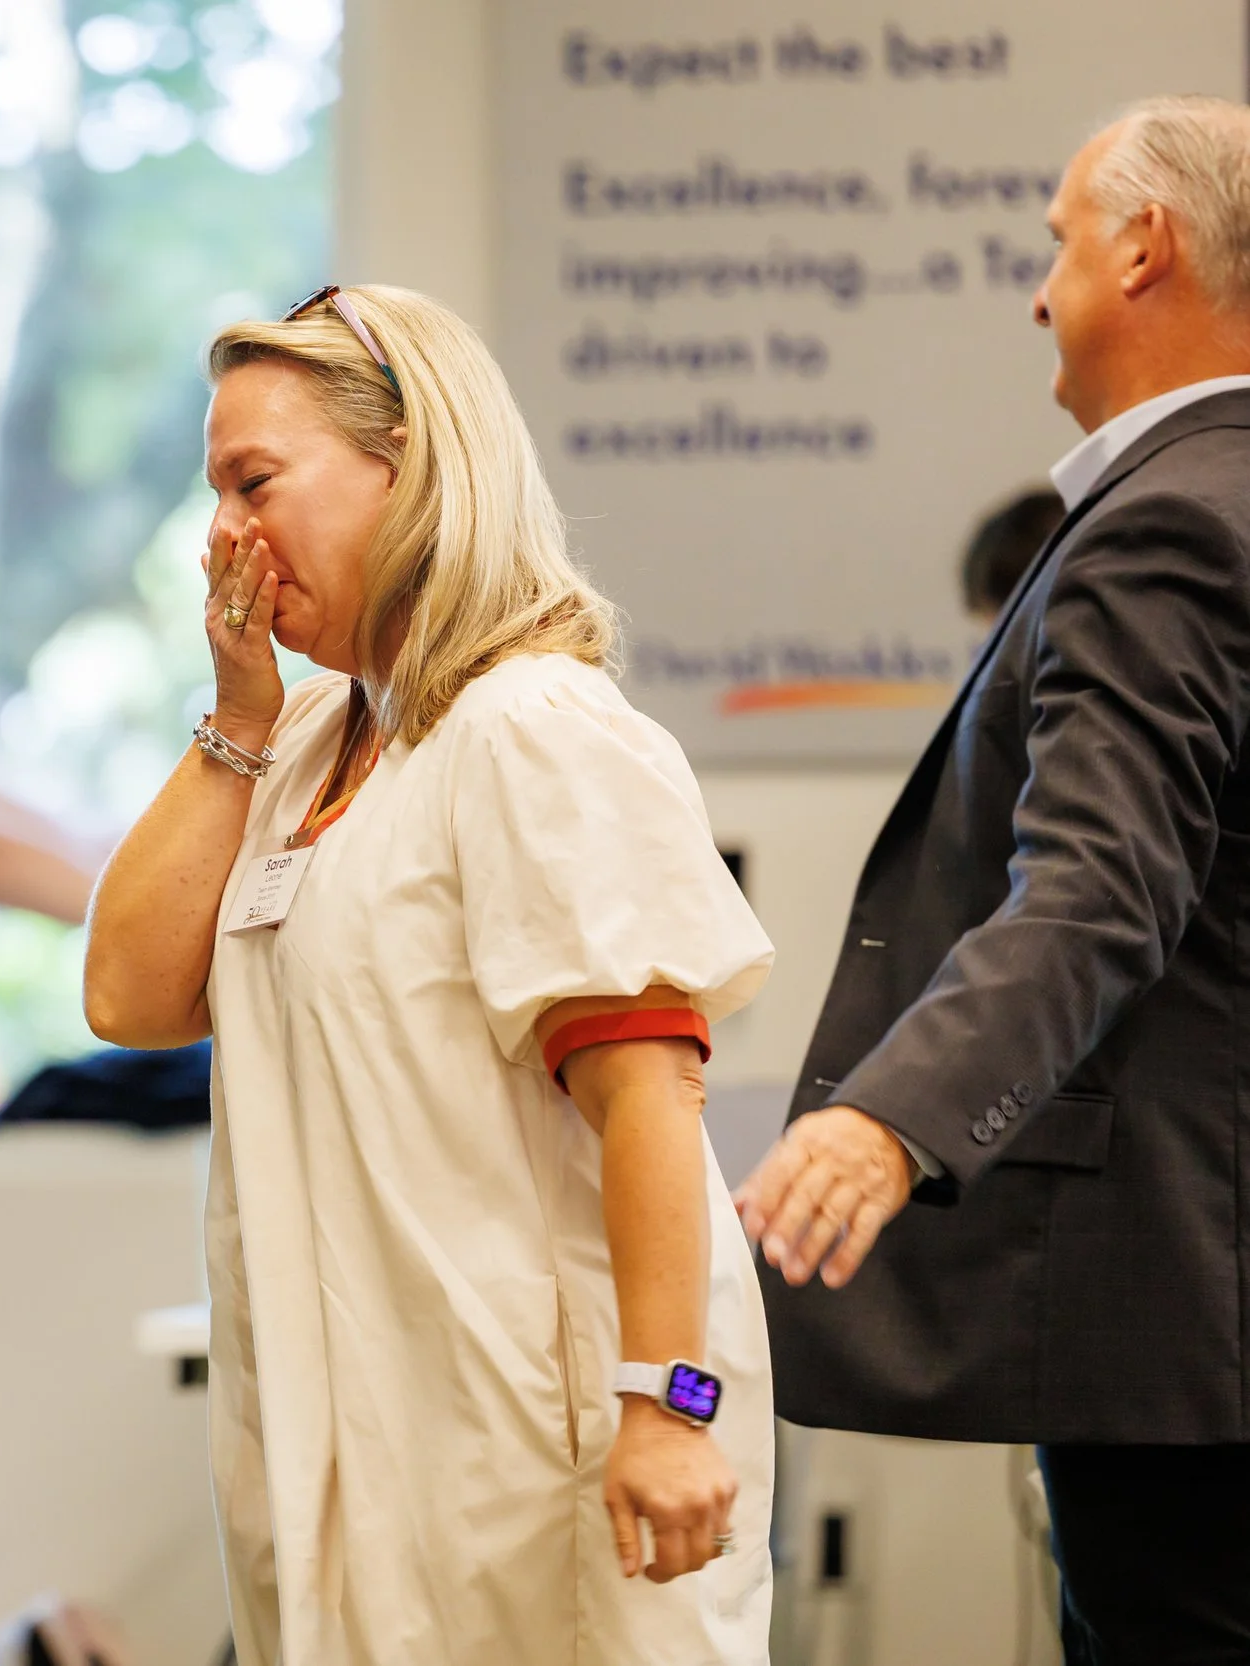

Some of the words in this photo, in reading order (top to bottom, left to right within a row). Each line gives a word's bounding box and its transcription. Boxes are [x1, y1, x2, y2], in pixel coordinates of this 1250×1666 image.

[561, 26, 760, 92] Expect
[774, 27, 864, 79] the
[884, 25, 1007, 79] best
[562, 325, 753, 377] driven
[766, 331, 828, 377] to
[563, 402, 872, 460] excellence
[265, 855, 293, 872] Sarah
